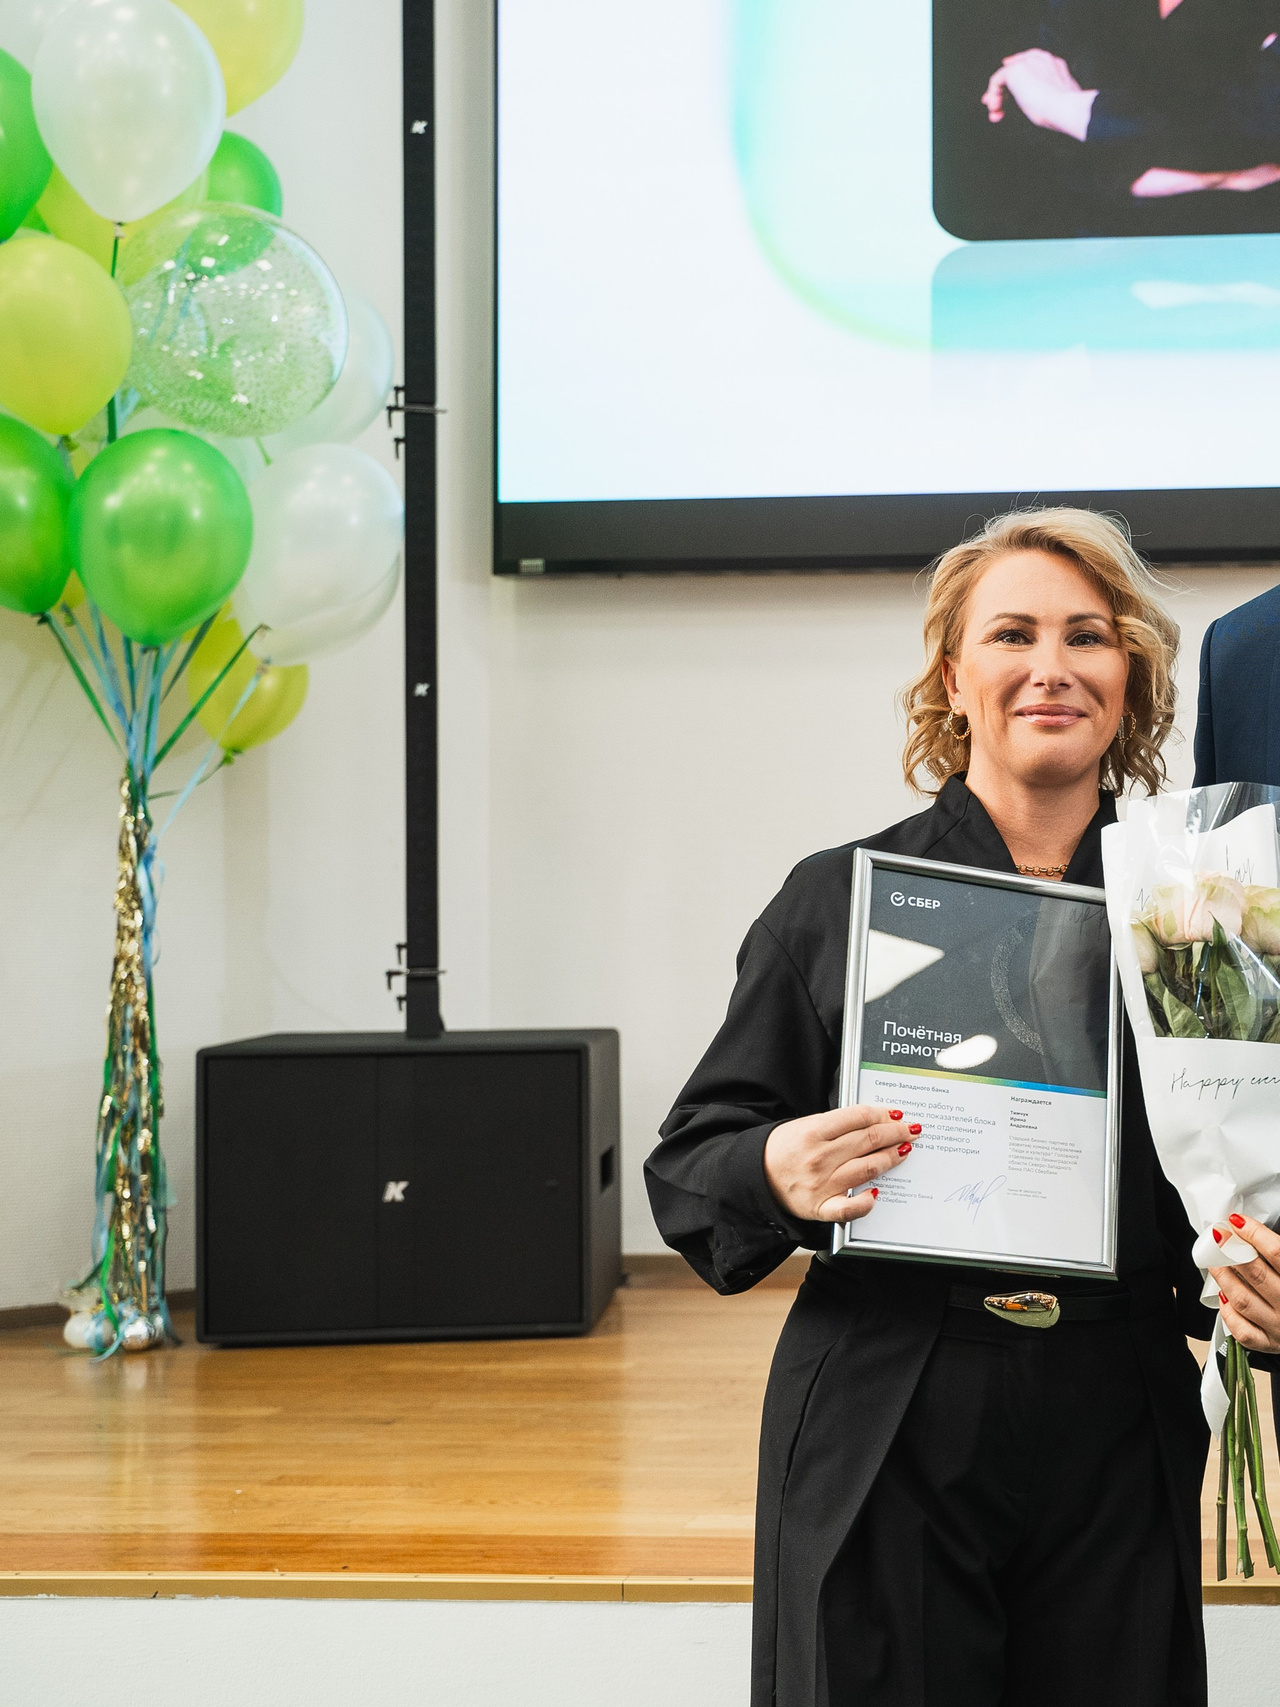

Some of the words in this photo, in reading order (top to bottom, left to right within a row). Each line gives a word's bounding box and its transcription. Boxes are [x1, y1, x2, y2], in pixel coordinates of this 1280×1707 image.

[908, 896, 941, 910] СБЕР
[883, 1020, 962, 1044] Почётная
[874, 1079, 931, 1092] Северо-Западного
[931, 1086, 950, 1094] банка
[1171, 1068, 1245, 1100] Happy
[874, 1095, 884, 1103] За
[886, 1097, 927, 1108] системную
[928, 1101, 955, 1112] работу
[1010, 1096, 1052, 1106] Награждается
[926, 1111, 973, 1124] показателей
[973, 1118, 996, 1126] блока
[936, 1124, 977, 1135] отделении
[918, 1132, 971, 1144] рпоративного
[936, 1145, 980, 1155] территории
